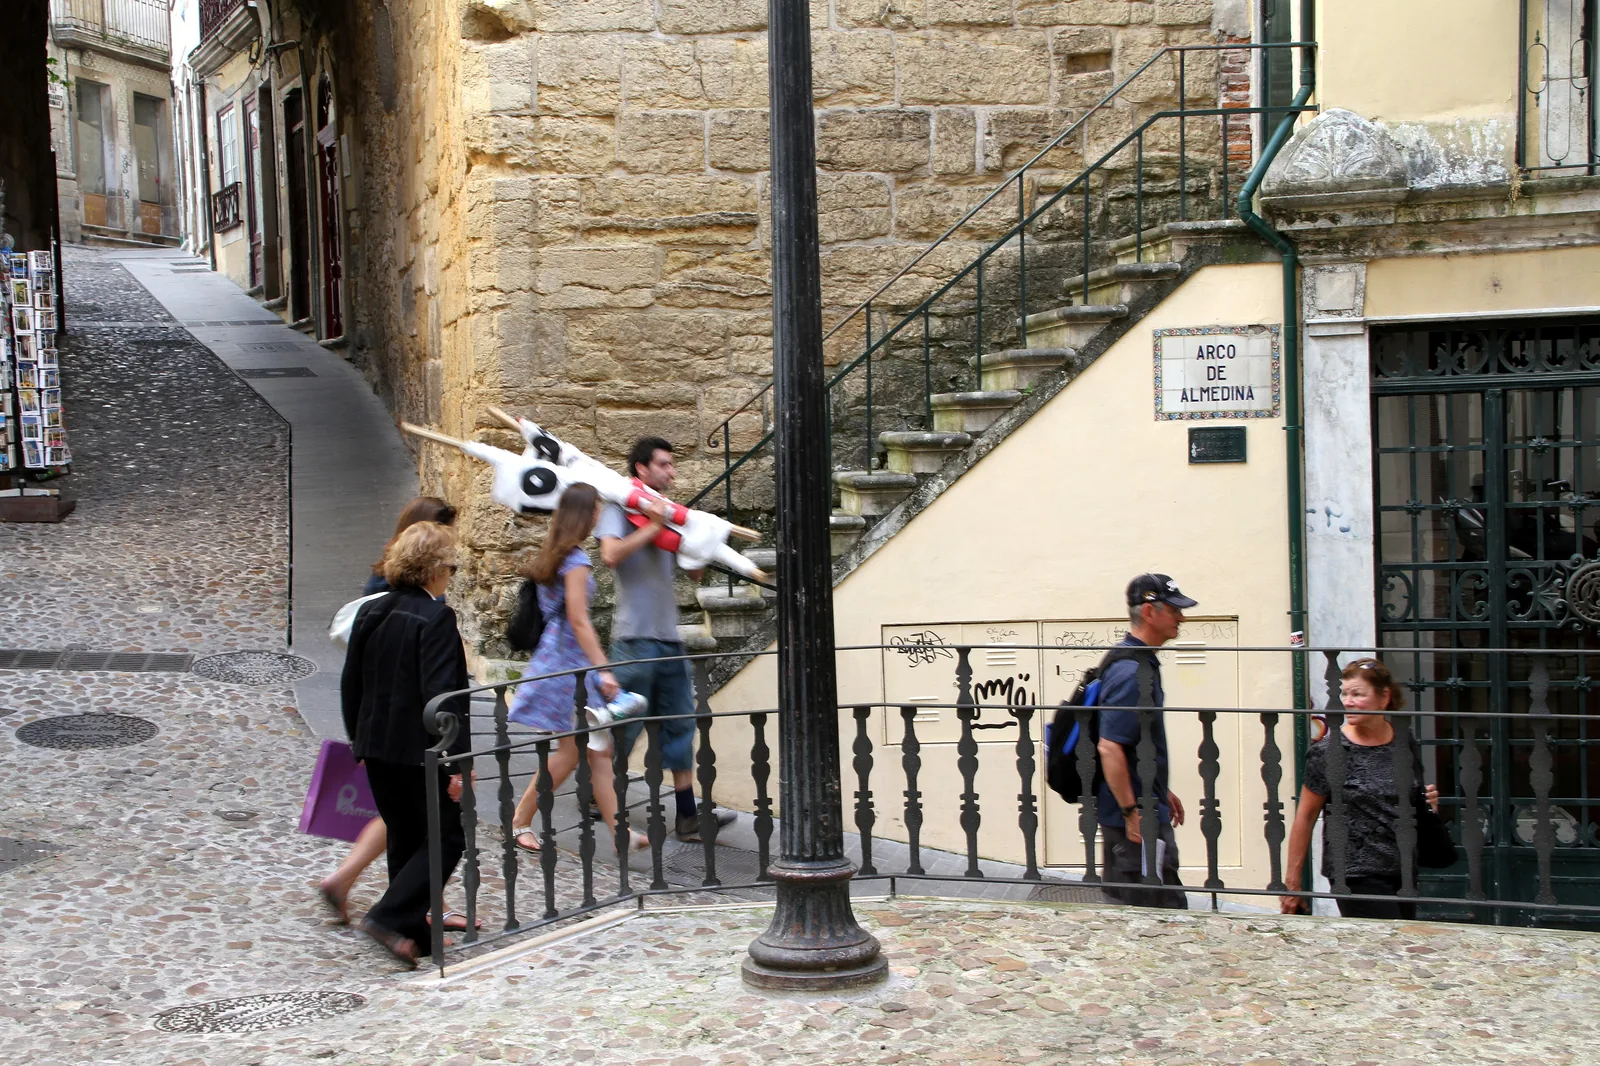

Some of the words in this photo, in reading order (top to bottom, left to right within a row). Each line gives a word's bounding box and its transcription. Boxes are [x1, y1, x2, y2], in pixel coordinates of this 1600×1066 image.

[1196, 344, 1236, 361] ARCO
[1206, 365, 1227, 381] DE
[1180, 386, 1255, 403] ALMEDINA
